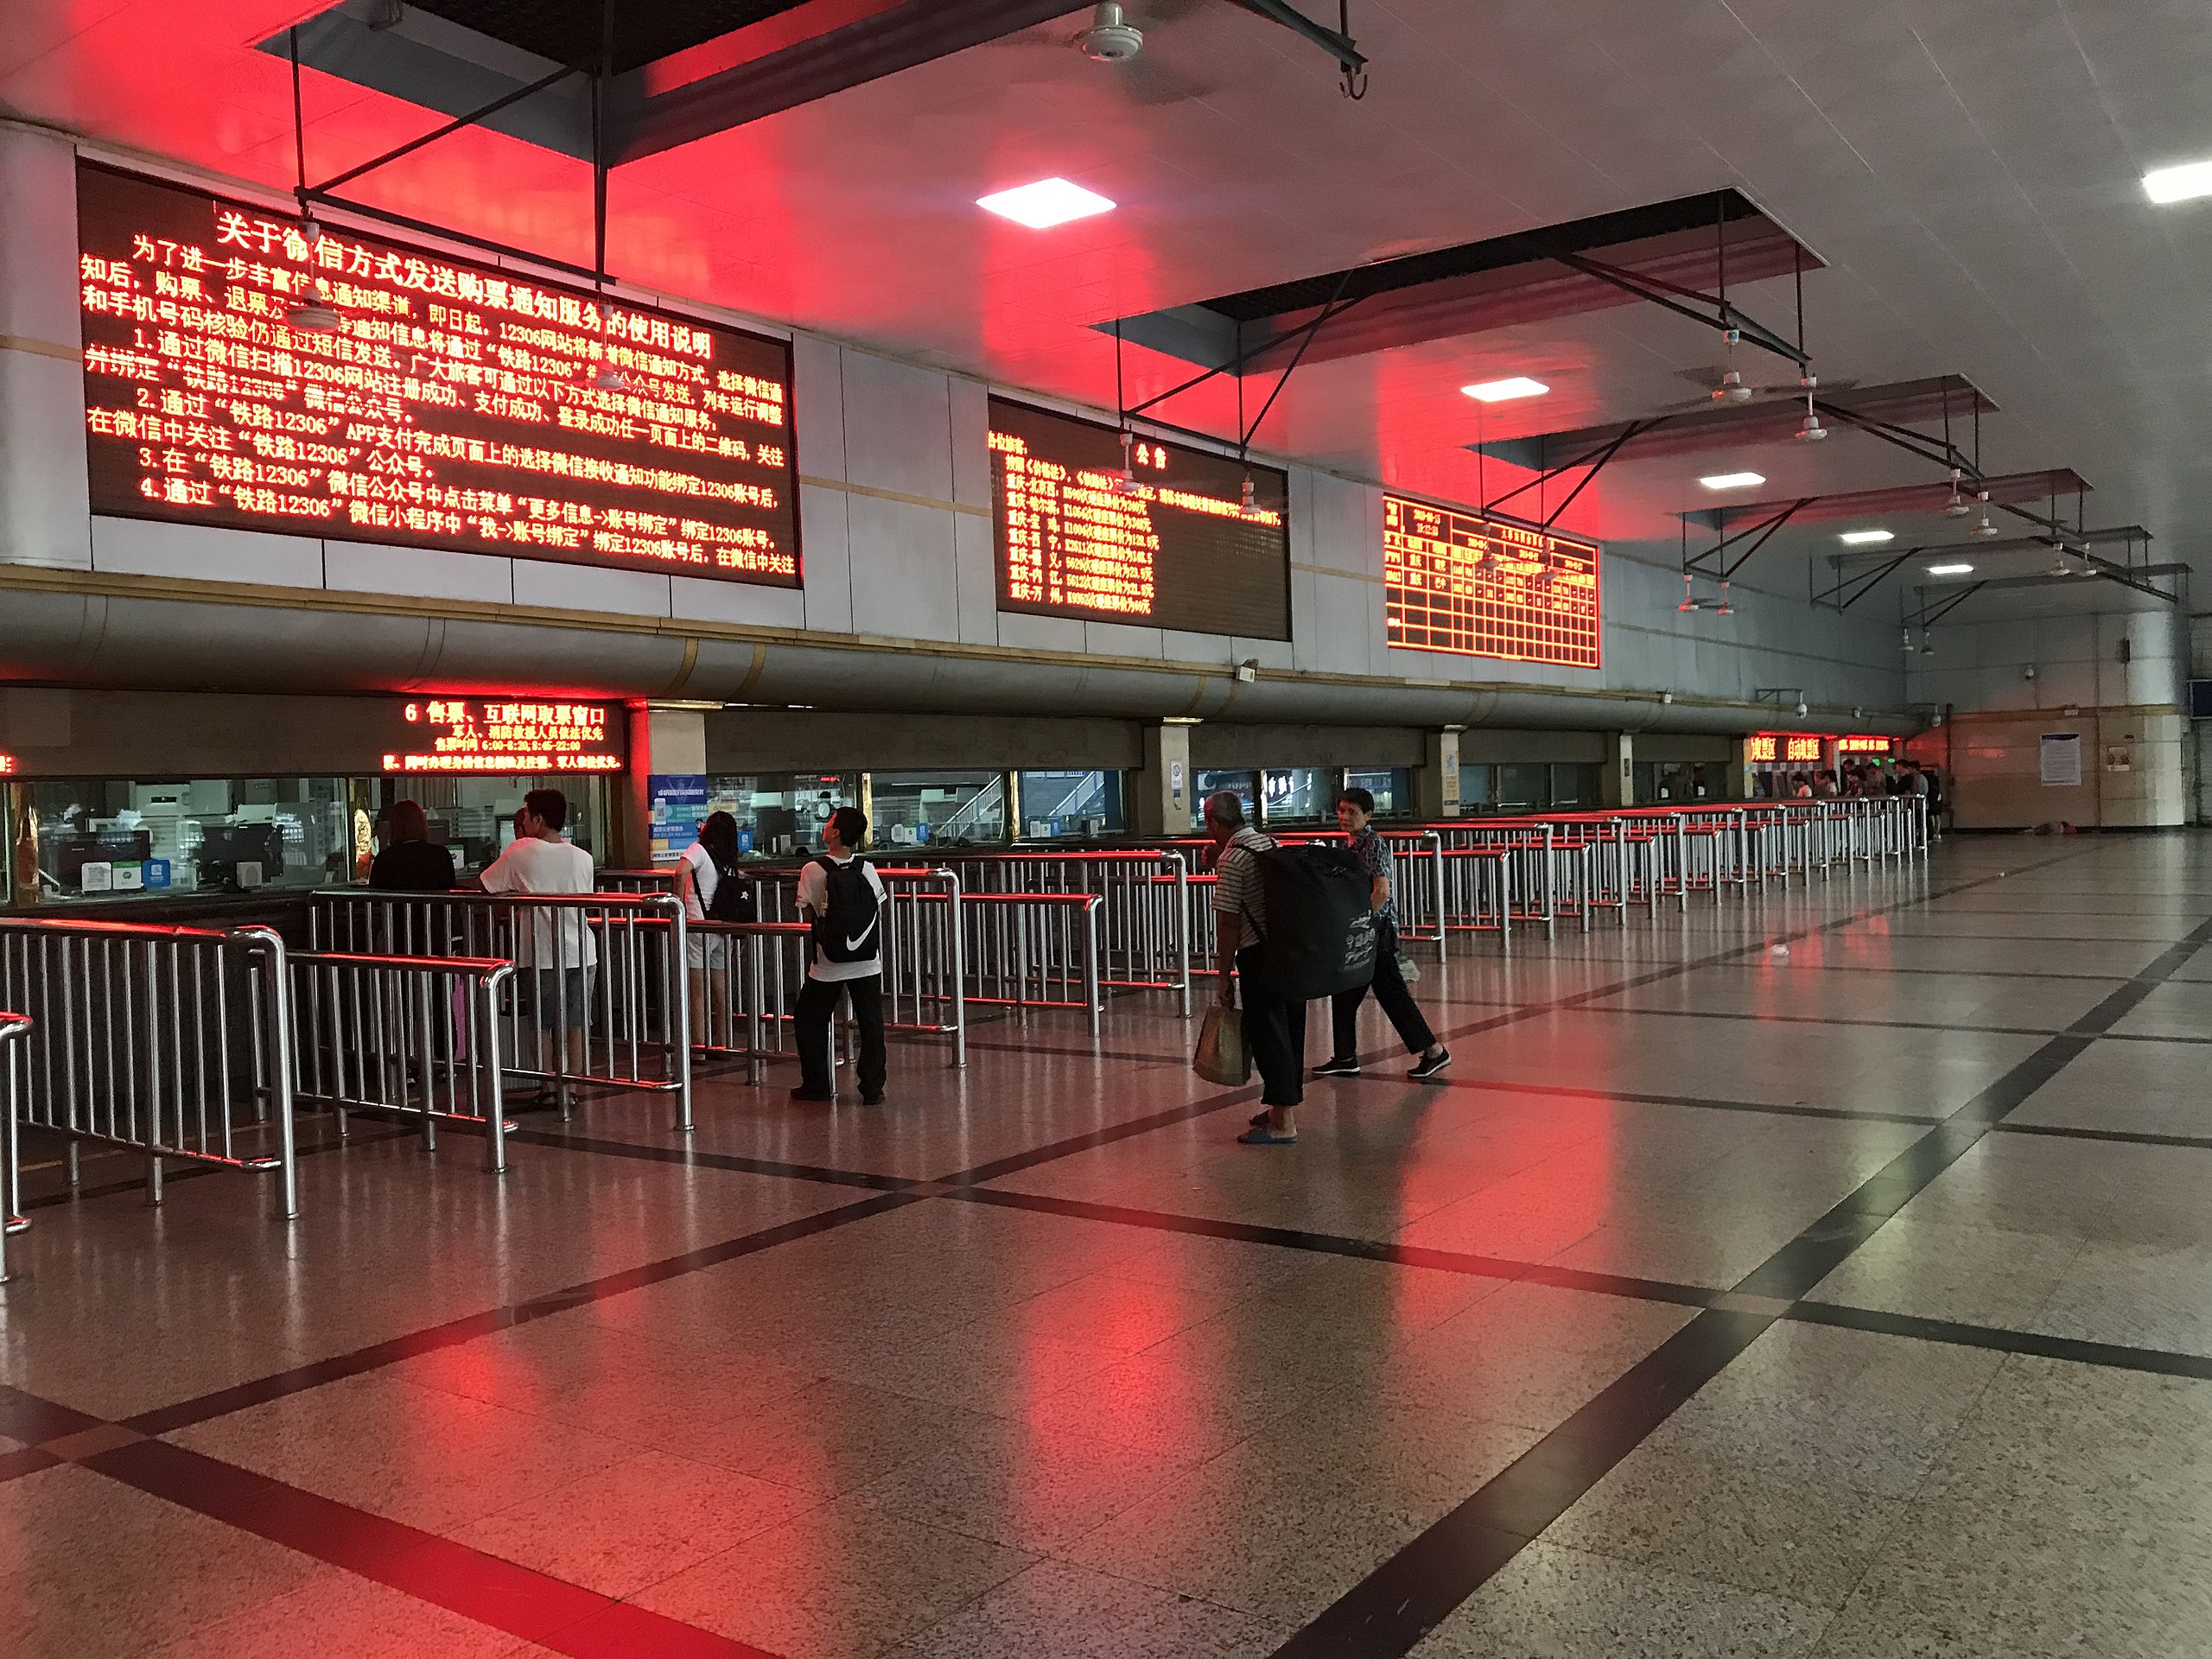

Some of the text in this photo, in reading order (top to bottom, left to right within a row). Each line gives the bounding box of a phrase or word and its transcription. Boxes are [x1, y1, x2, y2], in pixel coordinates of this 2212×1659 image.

[405, 701, 605, 726] 6 售票、互联网取票窗口
